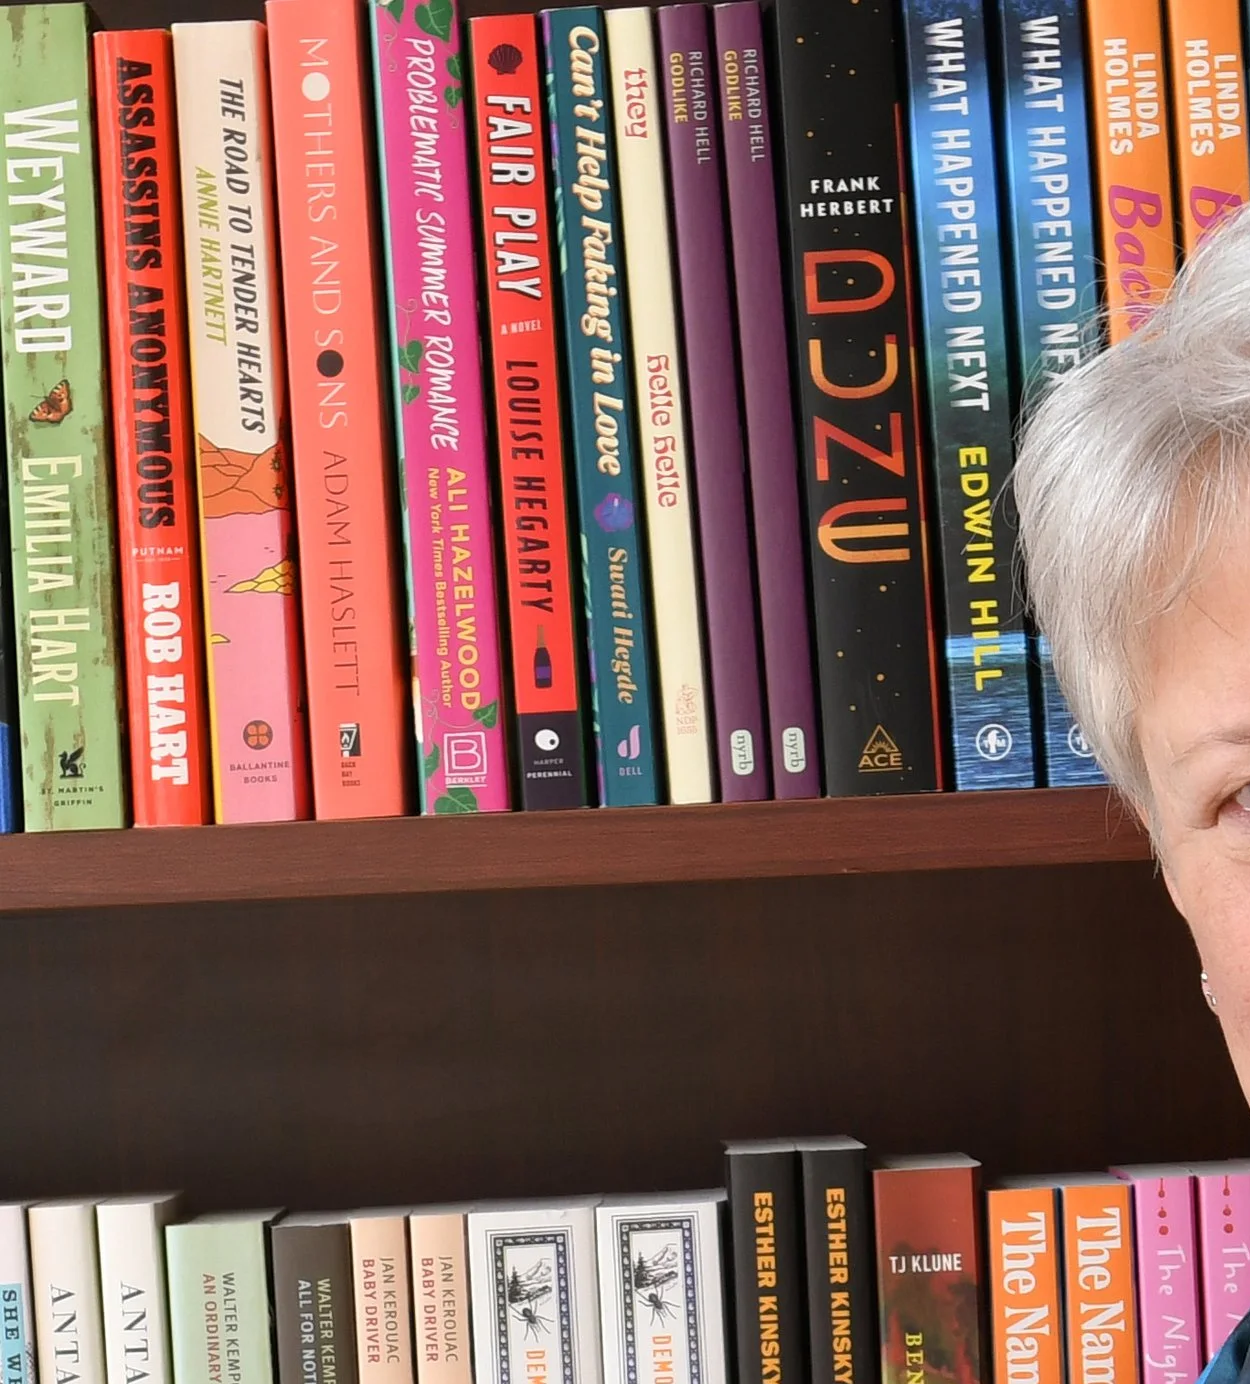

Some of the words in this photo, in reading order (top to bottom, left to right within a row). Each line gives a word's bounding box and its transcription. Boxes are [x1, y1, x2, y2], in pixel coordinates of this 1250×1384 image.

[219, 79, 246, 121] THE
[568, 25, 604, 122] Can't
[624, 67, 648, 140] they
[670, 52, 688, 124] GODLIKE
[689, 51, 707, 121] RICHARD
[924, 18, 968, 116] WHAT
[1104, 38, 1133, 155] HOLMES
[1132, 53, 1160, 139] LINDA
[405, 38, 445, 202] PROBLEMATIC
[485, 94, 536, 186] FAIR
[695, 127, 712, 164] HELL
[115, 56, 163, 270] ASSASSINS
[196, 166, 220, 232] ANNIE
[222, 128, 250, 195] ROAD
[572, 126, 610, 211] Help
[810, 176, 880, 196] FRANK
[3, 100, 80, 354] WEYWARD
[228, 205, 252, 233] TO
[801, 198, 894, 218] HERBERT
[931, 128, 983, 313] HAPPENED
[231, 244, 258, 334] TENDER
[307, 236, 341, 314] AND
[415, 208, 452, 325] SUMMER
[489, 205, 543, 302] PLAY
[580, 215, 620, 344] Faking
[200, 238, 228, 346] HARTNETT
[501, 325, 508, 335] A
[511, 320, 543, 334] NOVEL
[237, 342, 265, 433] HEARTS
[423, 336, 458, 452] ROMANCE
[590, 346, 622, 385] in
[947, 327, 990, 412] NEXT
[127, 283, 176, 530] ANONYMOUS
[506, 359, 545, 461] LOUISE
[593, 391, 623, 477] Love
[322, 449, 352, 546] ADAM
[428, 467, 440, 499] New
[430, 503, 442, 534] York
[446, 467, 468, 511] ALI
[957, 446, 996, 584] EDWIN
[22, 456, 83, 593] EMILIA
[132, 547, 184, 556] PUTNAM
[432, 538, 444, 578] Times
[512, 476, 555, 614] HEGARTY
[435, 580, 451, 656] Bestselling
[450, 524, 481, 711] HAZELWOOD
[608, 547, 631, 619] Swati
[31, 607, 91, 707] HART
[142, 581, 184, 664] ROB
[328, 559, 360, 696] HASLETT
[970, 598, 1003, 691] HILL
[440, 660, 452, 708] Author
[610, 625, 638, 705] Hegde
[146, 675, 190, 785] HART
[230, 761, 290, 771] BALLANTINE
[733, 733, 753, 770] nyrb
[859, 753, 903, 768] ACE
[54, 798, 93, 807] GRIFFIN
[244, 774, 278, 783] BOOKS
[619, 766, 642, 776] DELL
[380, 1257, 395, 1284] JAN
[754, 1191, 776, 1289] ESTHER
[888, 1255, 906, 1274] TJ
[912, 1252, 962, 1272] KLUNE
[1000, 1210, 1047, 1296] The
[2, 1289, 20, 1340] SHE
[203, 1273, 216, 1295] AN
[222, 1271, 238, 1333] WALTER
[298, 1279, 311, 1308] ALL
[317, 1278, 334, 1339] WALTER
[362, 1259, 377, 1300] BABY
[204, 1300, 222, 1384] ORDINARY
[300, 1311, 314, 1344] FOR
[364, 1305, 380, 1364] DRIVER
[383, 1290, 400, 1364] KEROUAC
